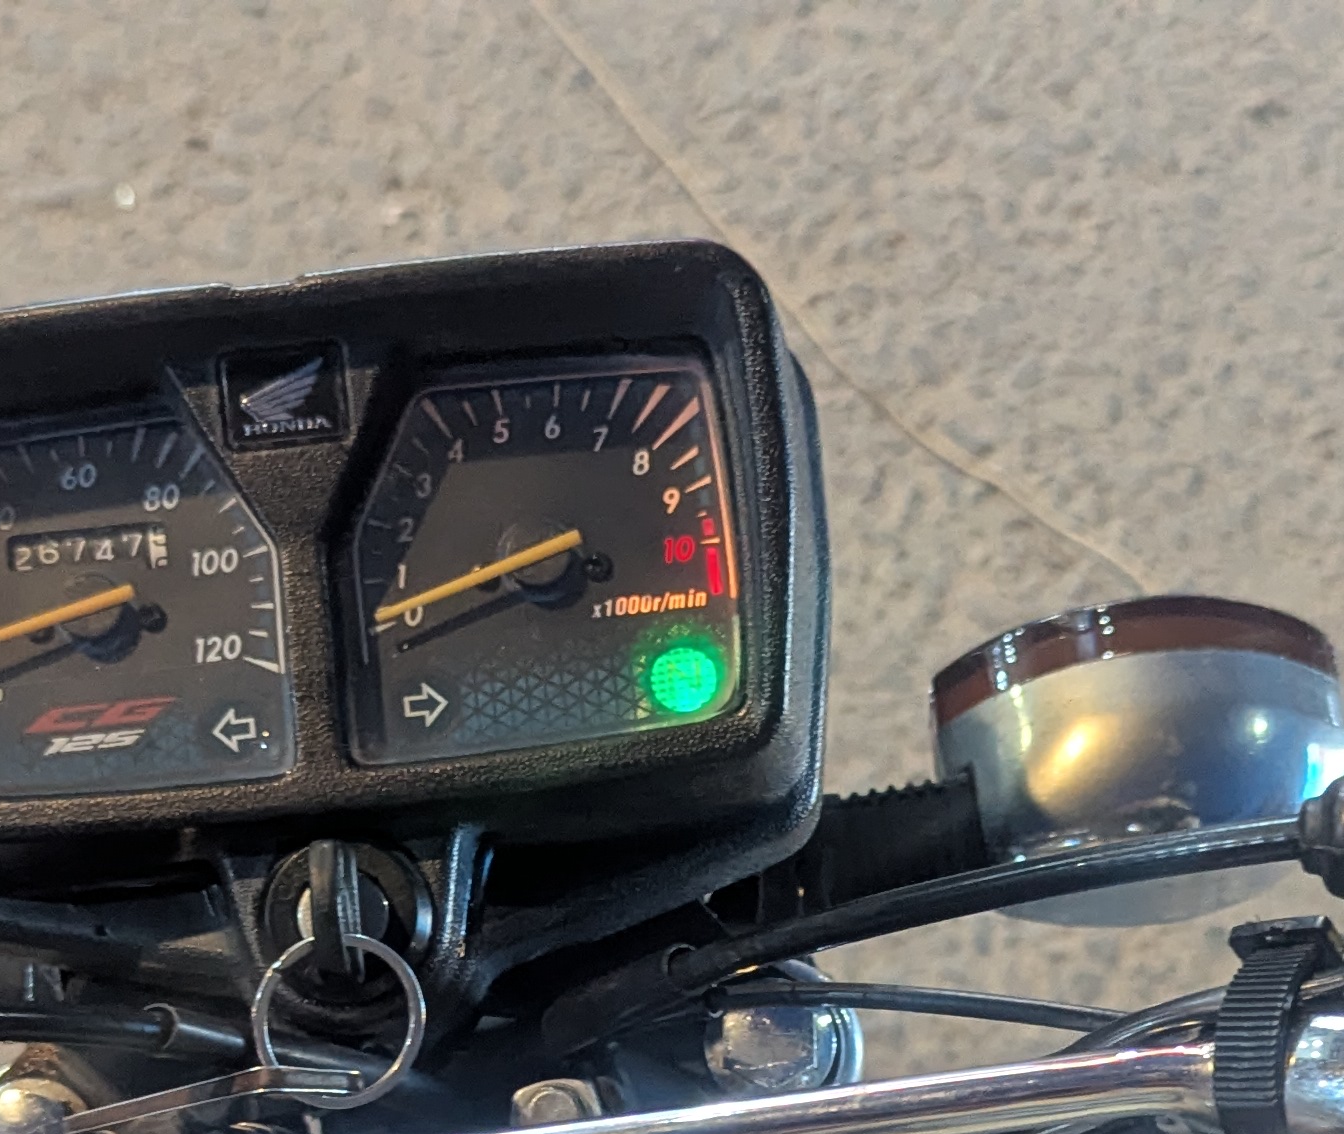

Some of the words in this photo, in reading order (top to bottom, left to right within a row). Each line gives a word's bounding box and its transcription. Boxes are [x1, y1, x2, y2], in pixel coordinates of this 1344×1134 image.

[242, 416, 331, 436] HONDA
[493, 419, 510, 444] 5
[544, 415, 561, 439] 6
[449, 438, 464, 463] 4
[593, 427, 607, 453] 7
[632, 448, 650, 477] 8
[60, 464, 97, 491] 60
[415, 473, 431, 499] 3
[144, 484, 181, 512] 80
[662, 488, 681, 516] 9
[397, 518, 414, 543] 2
[191, 548, 239, 577] 100
[664, 536, 696, 564] 10
[397, 564, 407, 590] 1
[404, 605, 424, 627] 0
[196, 635, 243, 664] 120
[25, 697, 176, 734] CG
[44, 728, 146, 756] 125
